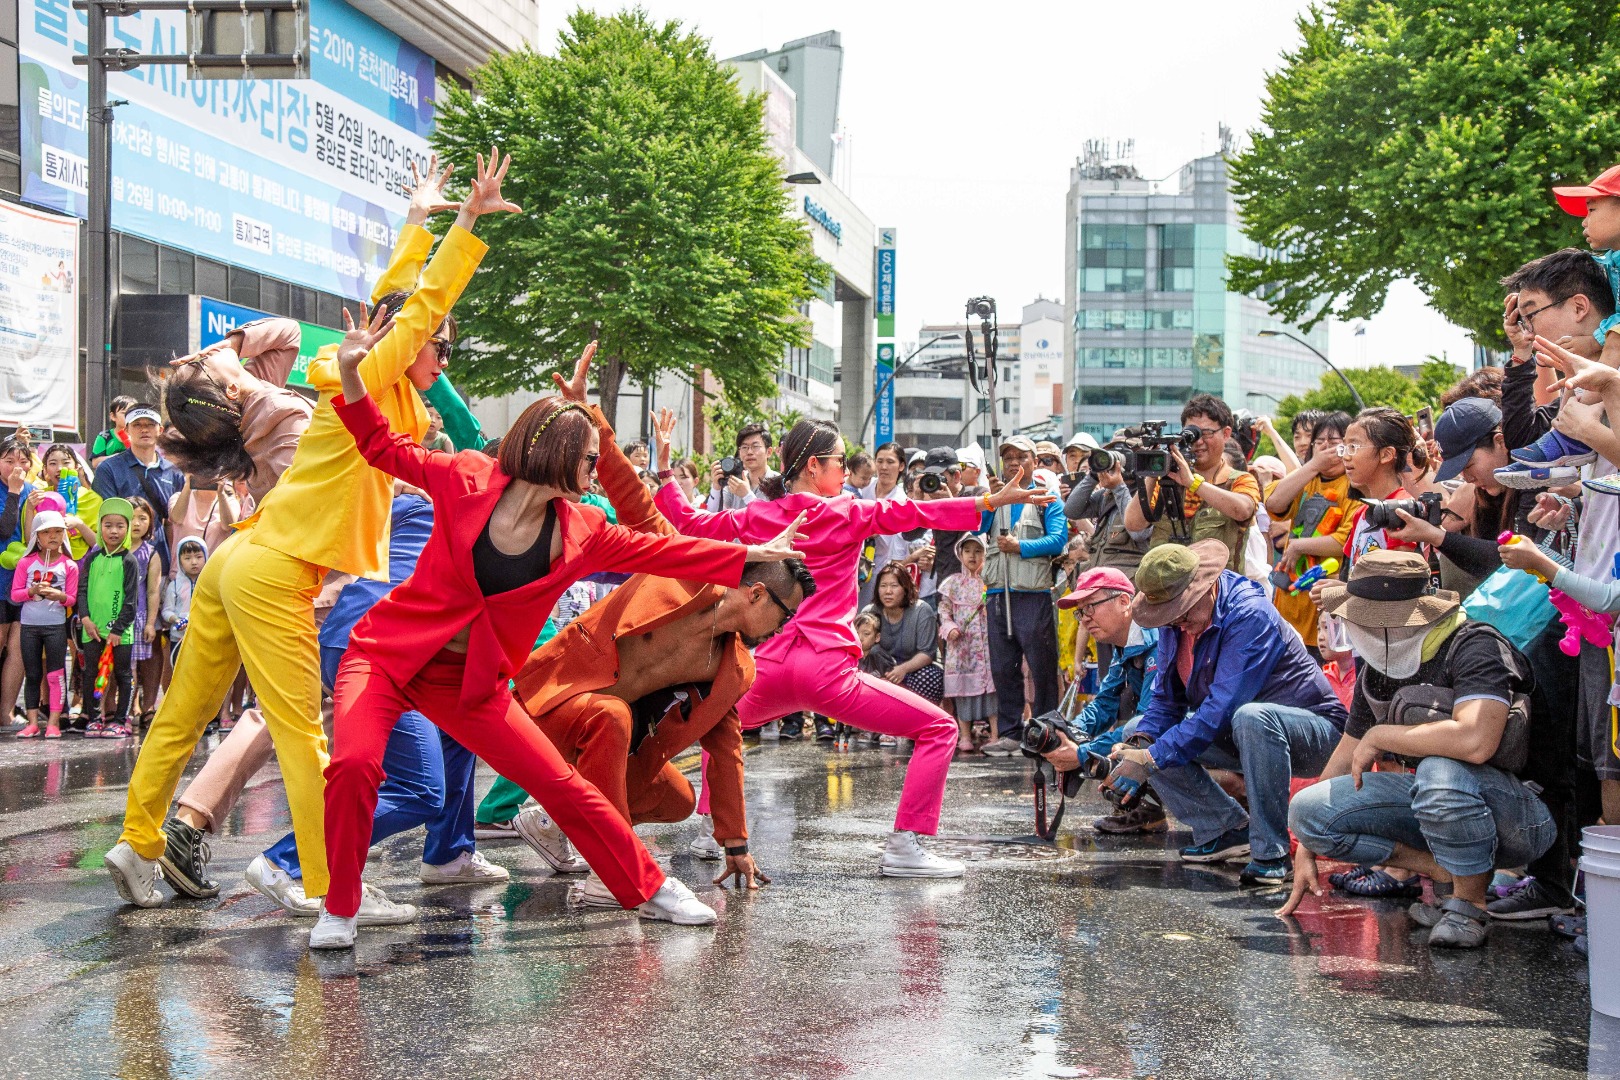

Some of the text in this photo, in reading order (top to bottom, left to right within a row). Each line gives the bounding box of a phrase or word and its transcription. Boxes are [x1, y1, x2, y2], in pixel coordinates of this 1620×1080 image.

[323, 28, 355, 72] 2019
[359, 46, 419, 110] 춘천마임축제
[316, 102, 334, 135] 5월
[338, 113, 363, 149] 26일
[156, 133, 190, 173] 행사로
[194, 150, 216, 182] 인해
[218, 160, 249, 196] 교통이
[316, 133, 347, 171] 중앙로
[127, 181, 154, 212] 26일
[236, 219, 271, 250] 통제구역
[881, 252, 892, 316] SC제일은행
[208, 312, 235, 336] NH
[1037, 788, 1045, 812] Canon
